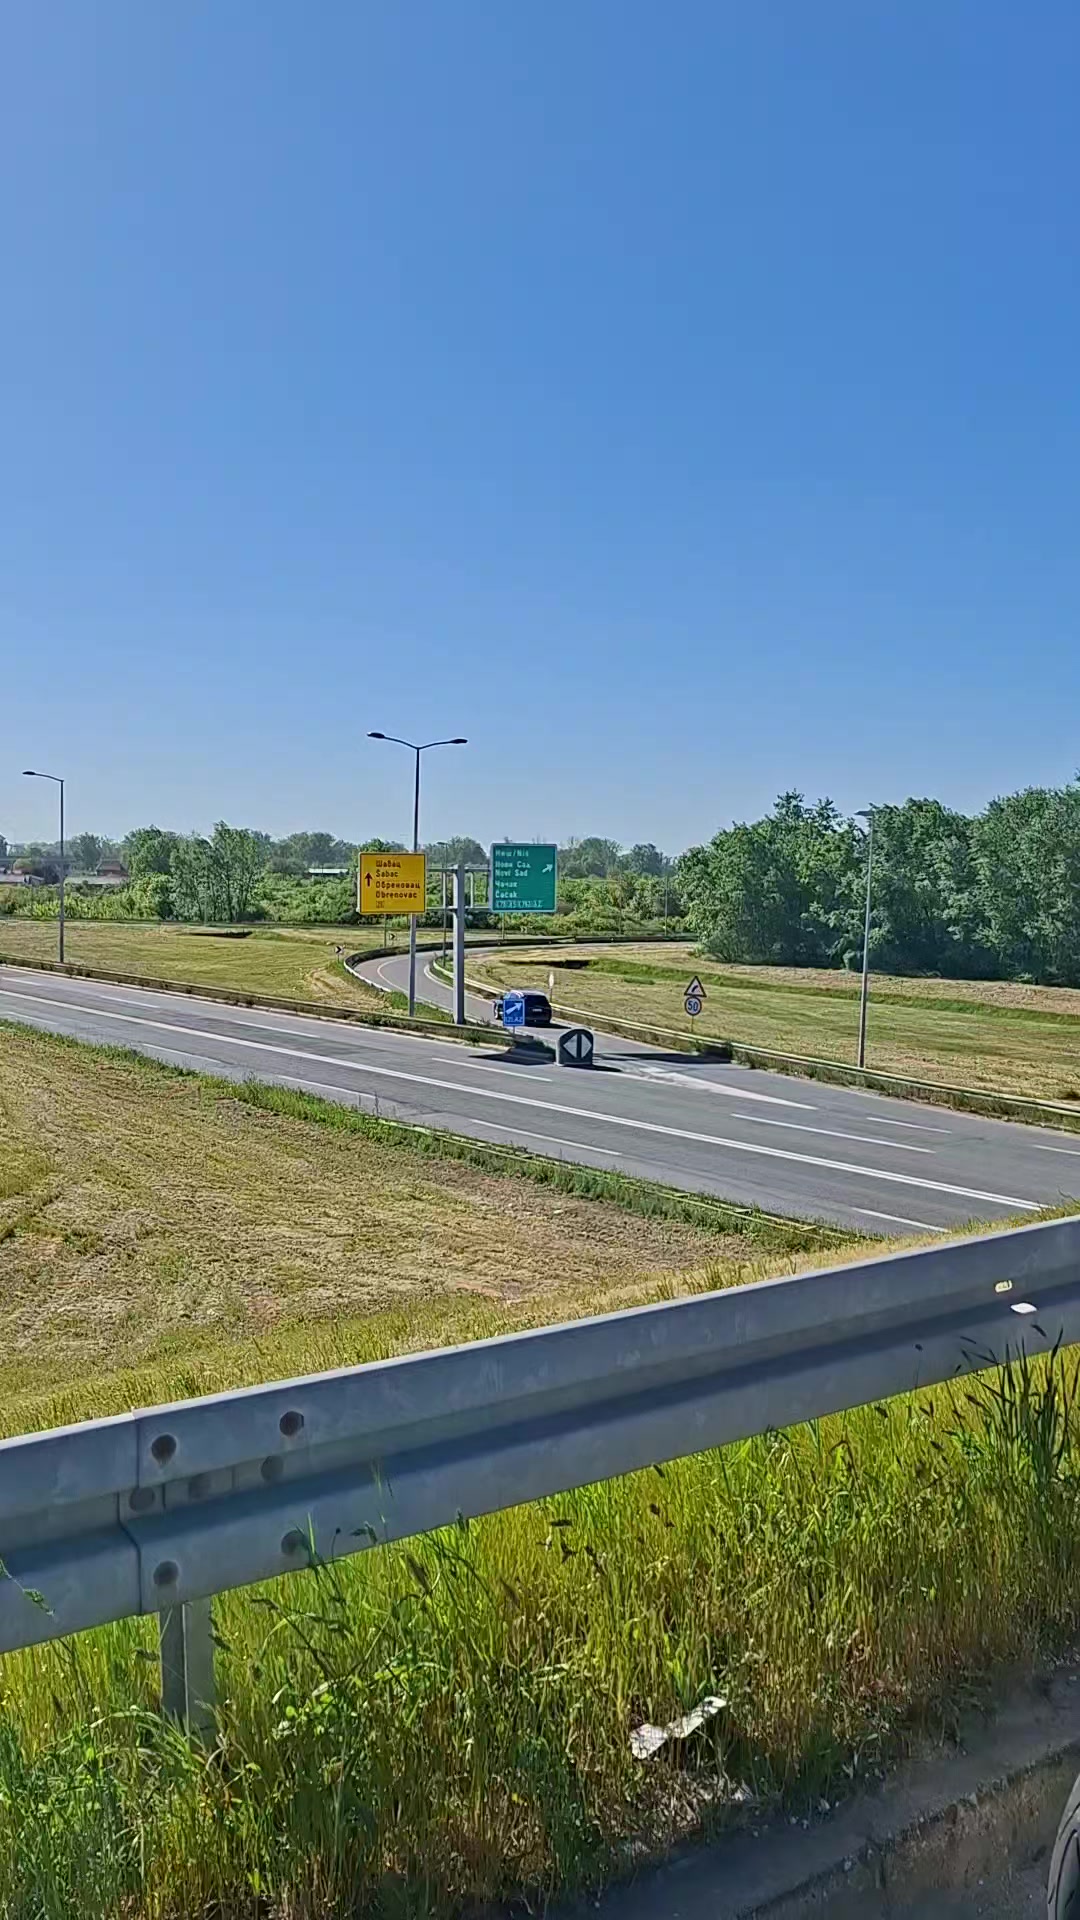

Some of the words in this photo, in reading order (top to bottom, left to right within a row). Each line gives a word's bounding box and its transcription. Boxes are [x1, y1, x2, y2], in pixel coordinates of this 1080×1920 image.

[375, 869, 399, 878] Šabac
[375, 881, 420, 890] Обреновац
[375, 890, 418, 899] Obrenovac
[687, 1000, 699, 1012] 50
